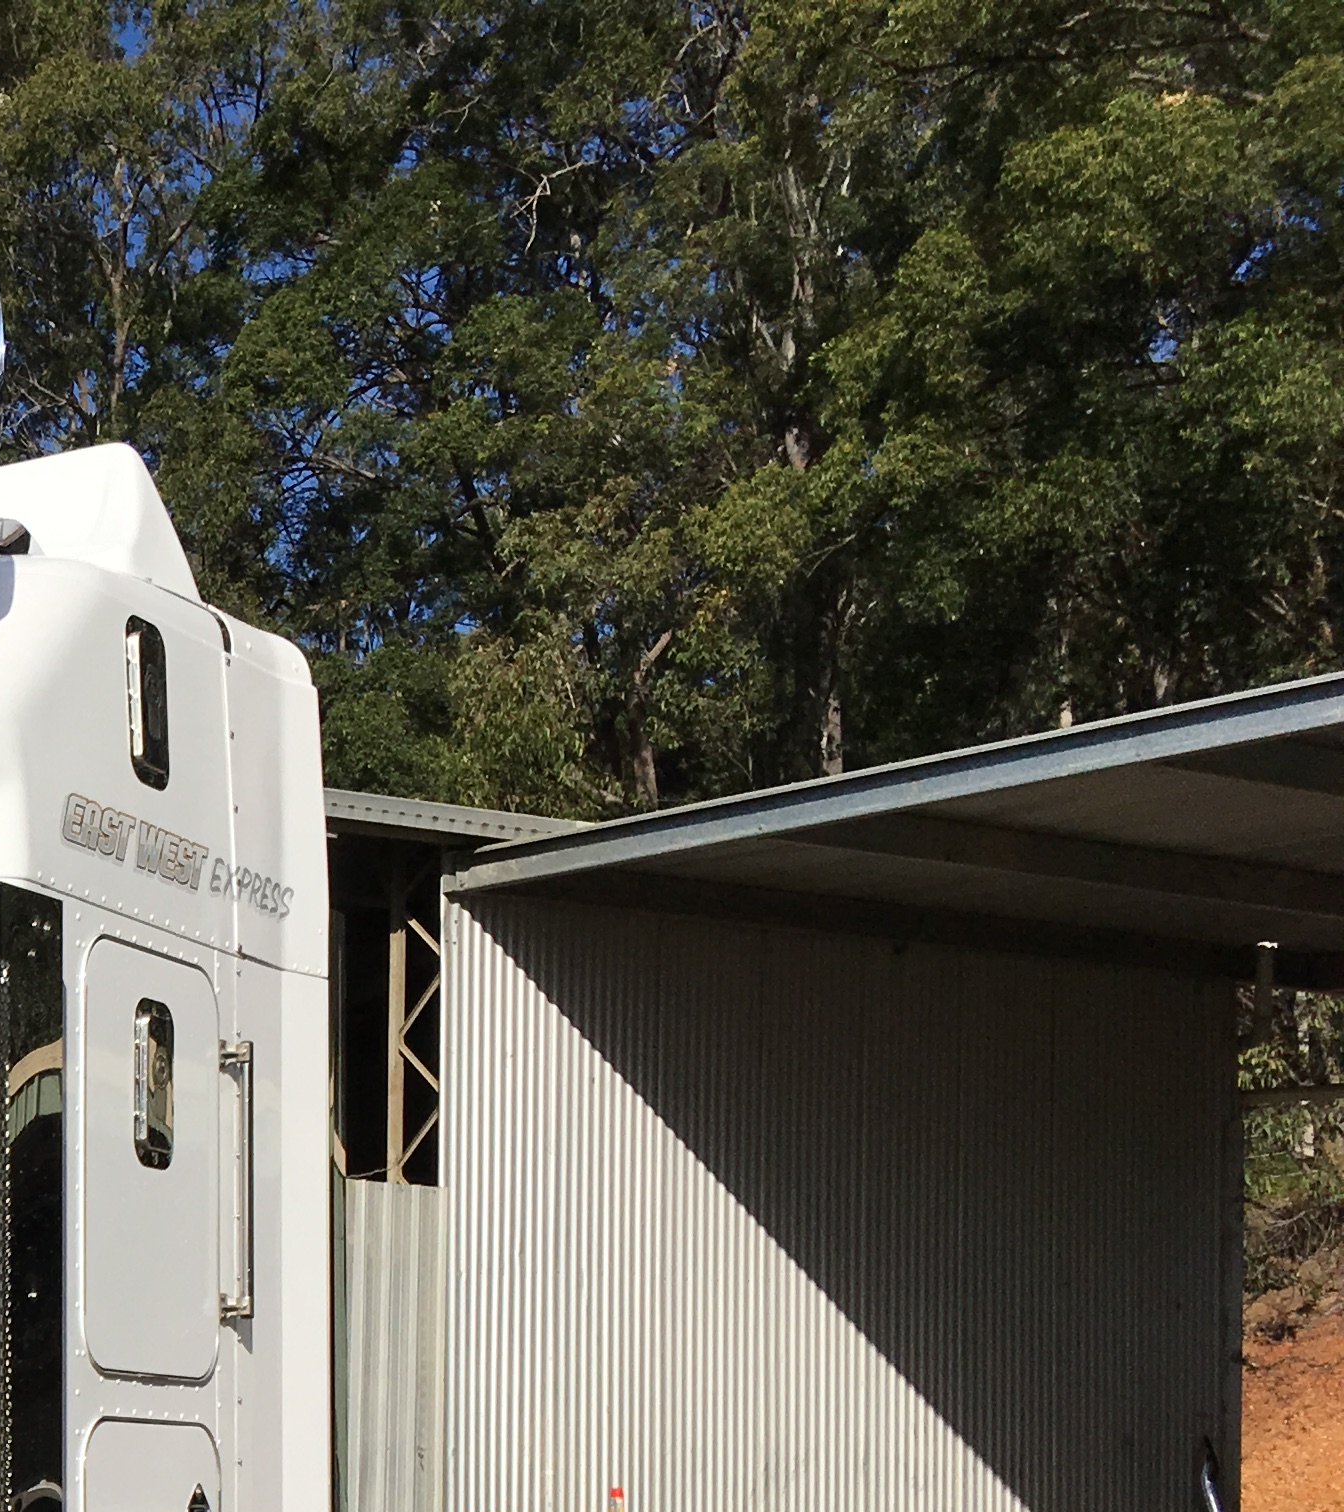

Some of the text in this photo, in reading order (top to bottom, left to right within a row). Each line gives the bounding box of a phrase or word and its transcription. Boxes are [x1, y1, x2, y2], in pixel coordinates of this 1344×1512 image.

[62, 792, 295, 919] EAST WEST EXPRESS
